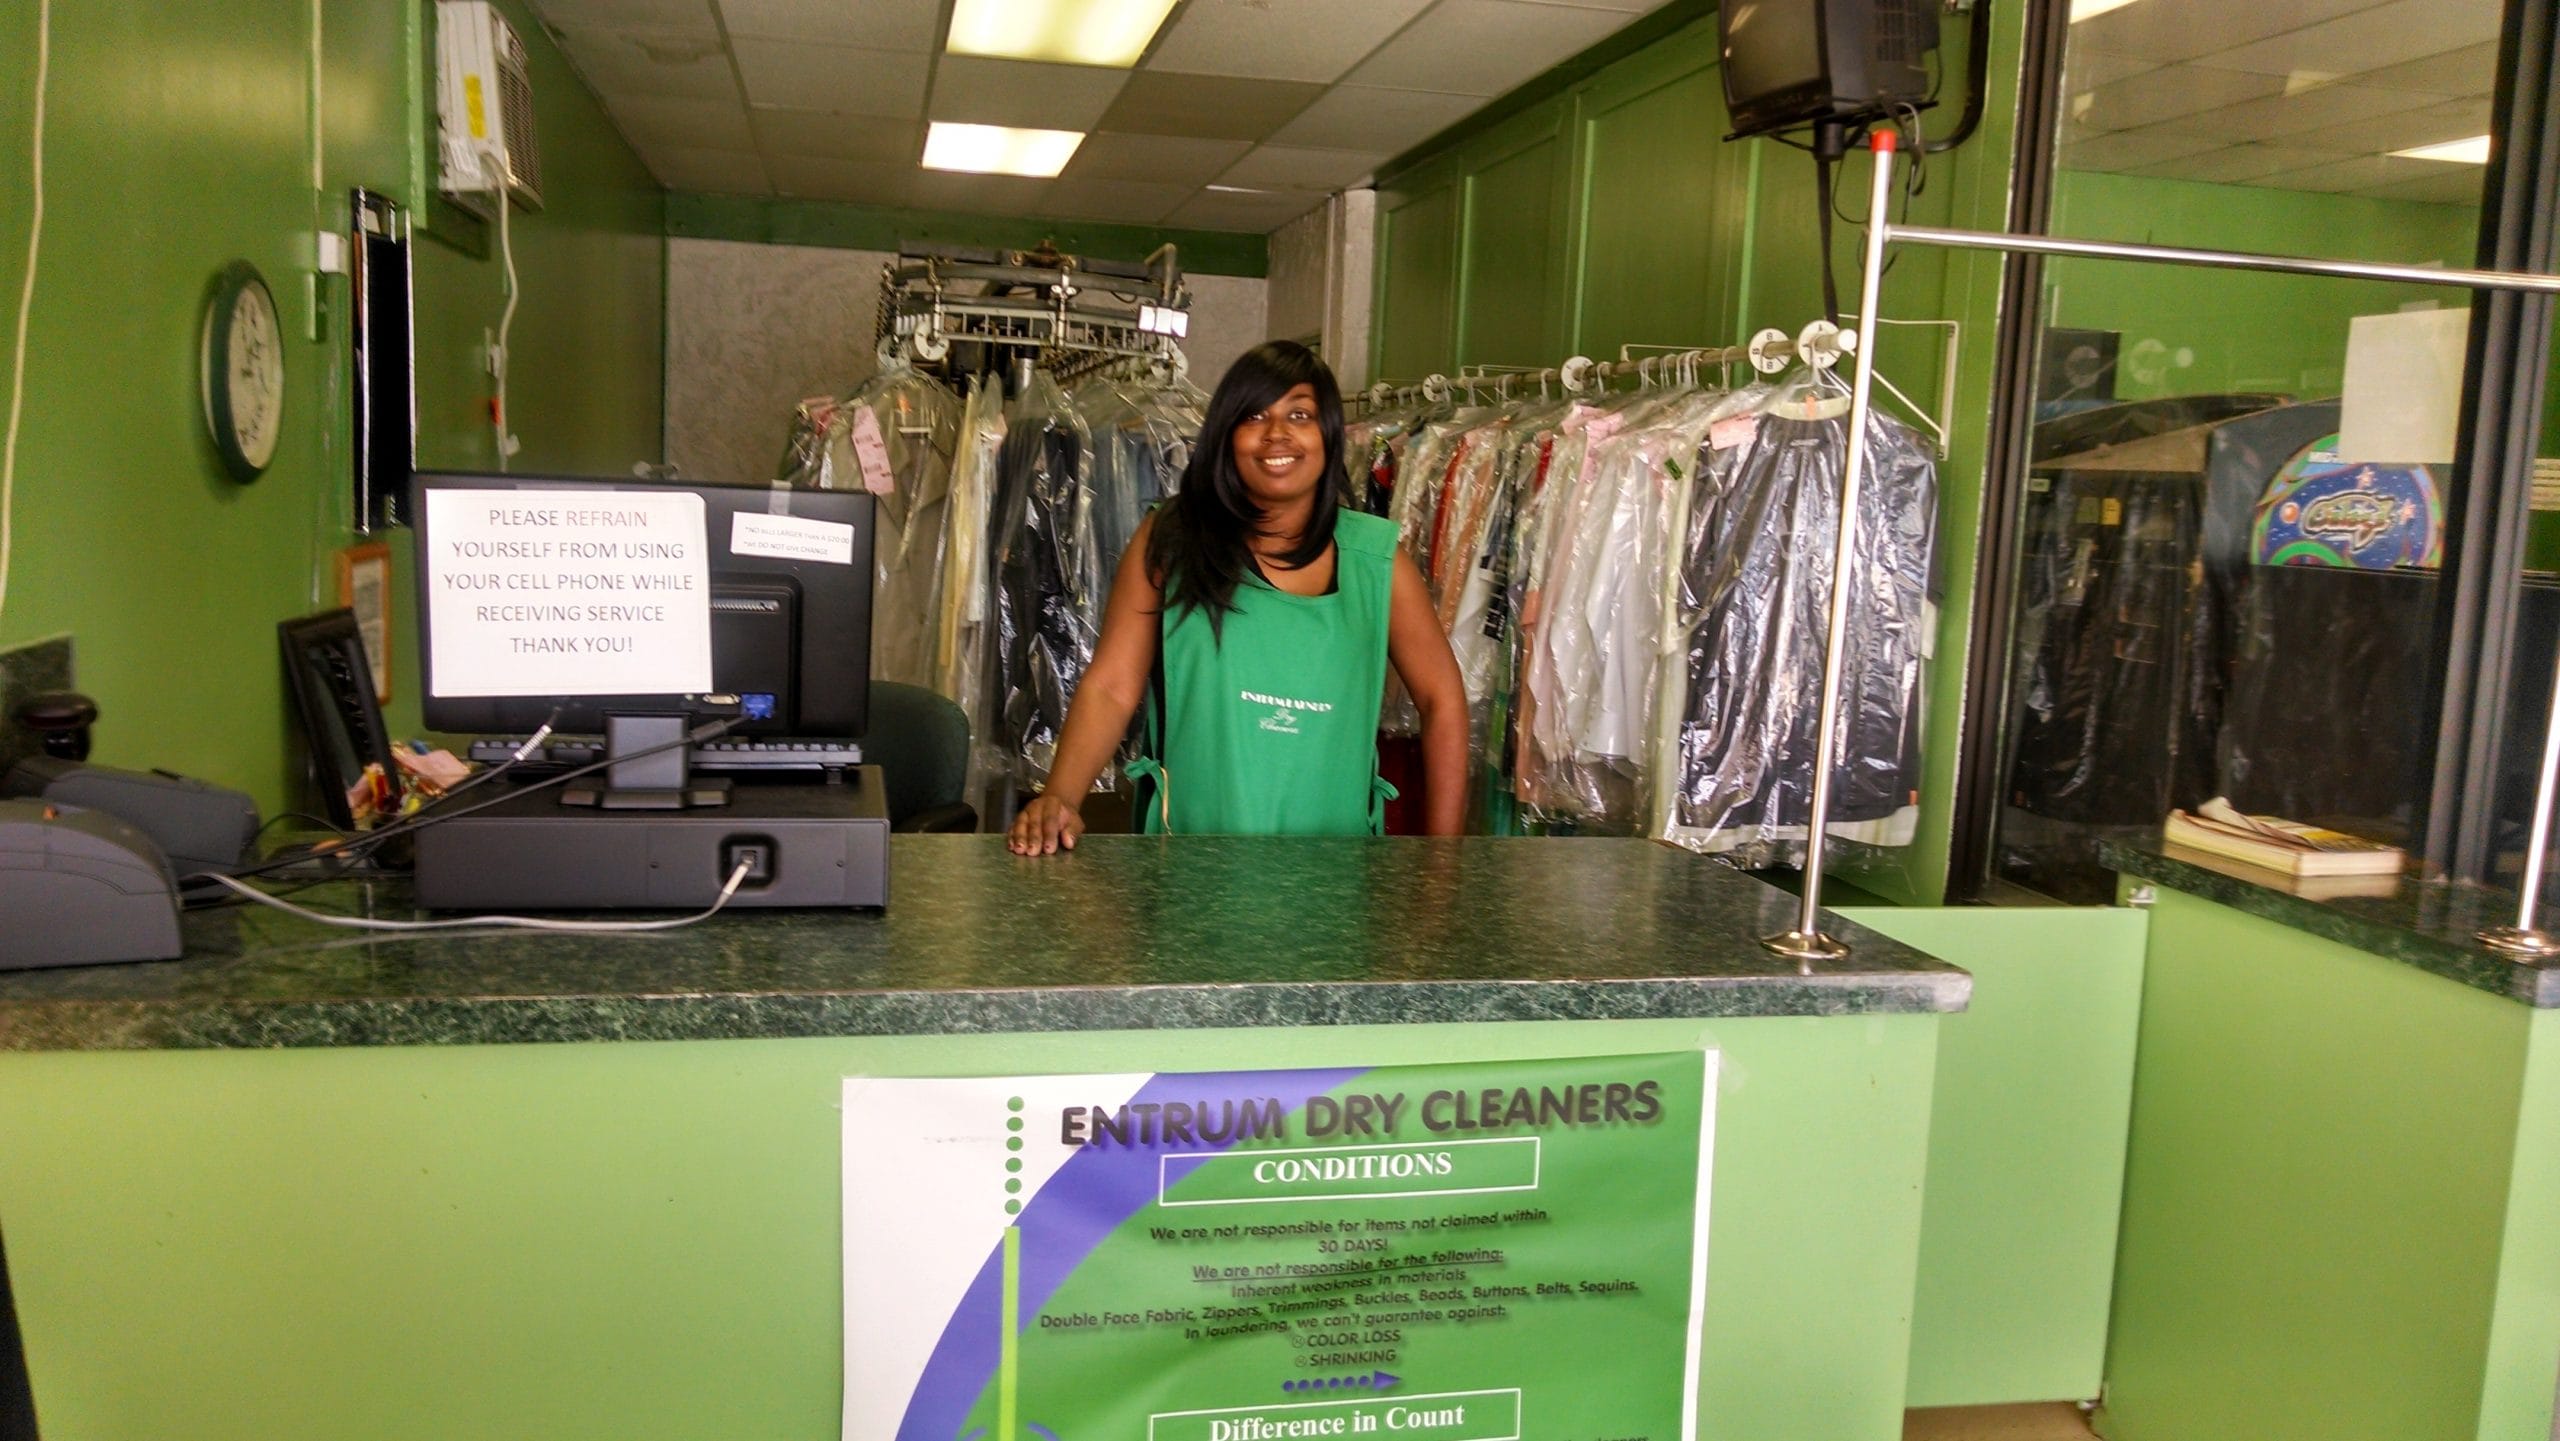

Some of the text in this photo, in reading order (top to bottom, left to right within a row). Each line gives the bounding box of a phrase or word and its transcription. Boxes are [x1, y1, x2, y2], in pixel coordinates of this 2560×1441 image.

[489, 509, 648, 527] PLEASE REFRAIN
[452, 541, 684, 560] YOURSELF FROM USING
[444, 573, 693, 591] YOUR CELL PHONE WHILE
[477, 605, 665, 622] RECEIVING SERVICE
[510, 637, 633, 653] THANK YOU!
[1061, 1080, 1661, 1147] ENTRUM DRY CLEANERS
[1253, 1151, 1453, 1184] CONDITIONS
[1150, 1209, 1547, 1240] We are not responsible for items not claimed within
[1318, 1237, 1389, 1253] 30 DAYS!
[1193, 1247, 1504, 1280] We are not responsible for the following:
[1231, 1268, 1467, 1299] Inherent weakness in materials
[1040, 1278, 1638, 1329] Double Face Fabric, Zippers, Trimmings, Buckles, Beads, Buttons, Belts, Sequins.
[1185, 1327, 1200, 1340] In
[1205, 1319, 1292, 1339] laundering,
[1297, 1317, 1318, 1329] we
[1323, 1312, 1360, 1328] can't
[1365, 1309, 1443, 1328] guarantee
[1307, 1329, 1400, 1349] COLOR LOSS
[1309, 1349, 1396, 1367] SHRINKING
[1208, 1404, 1465, 1441] Difference in Count
